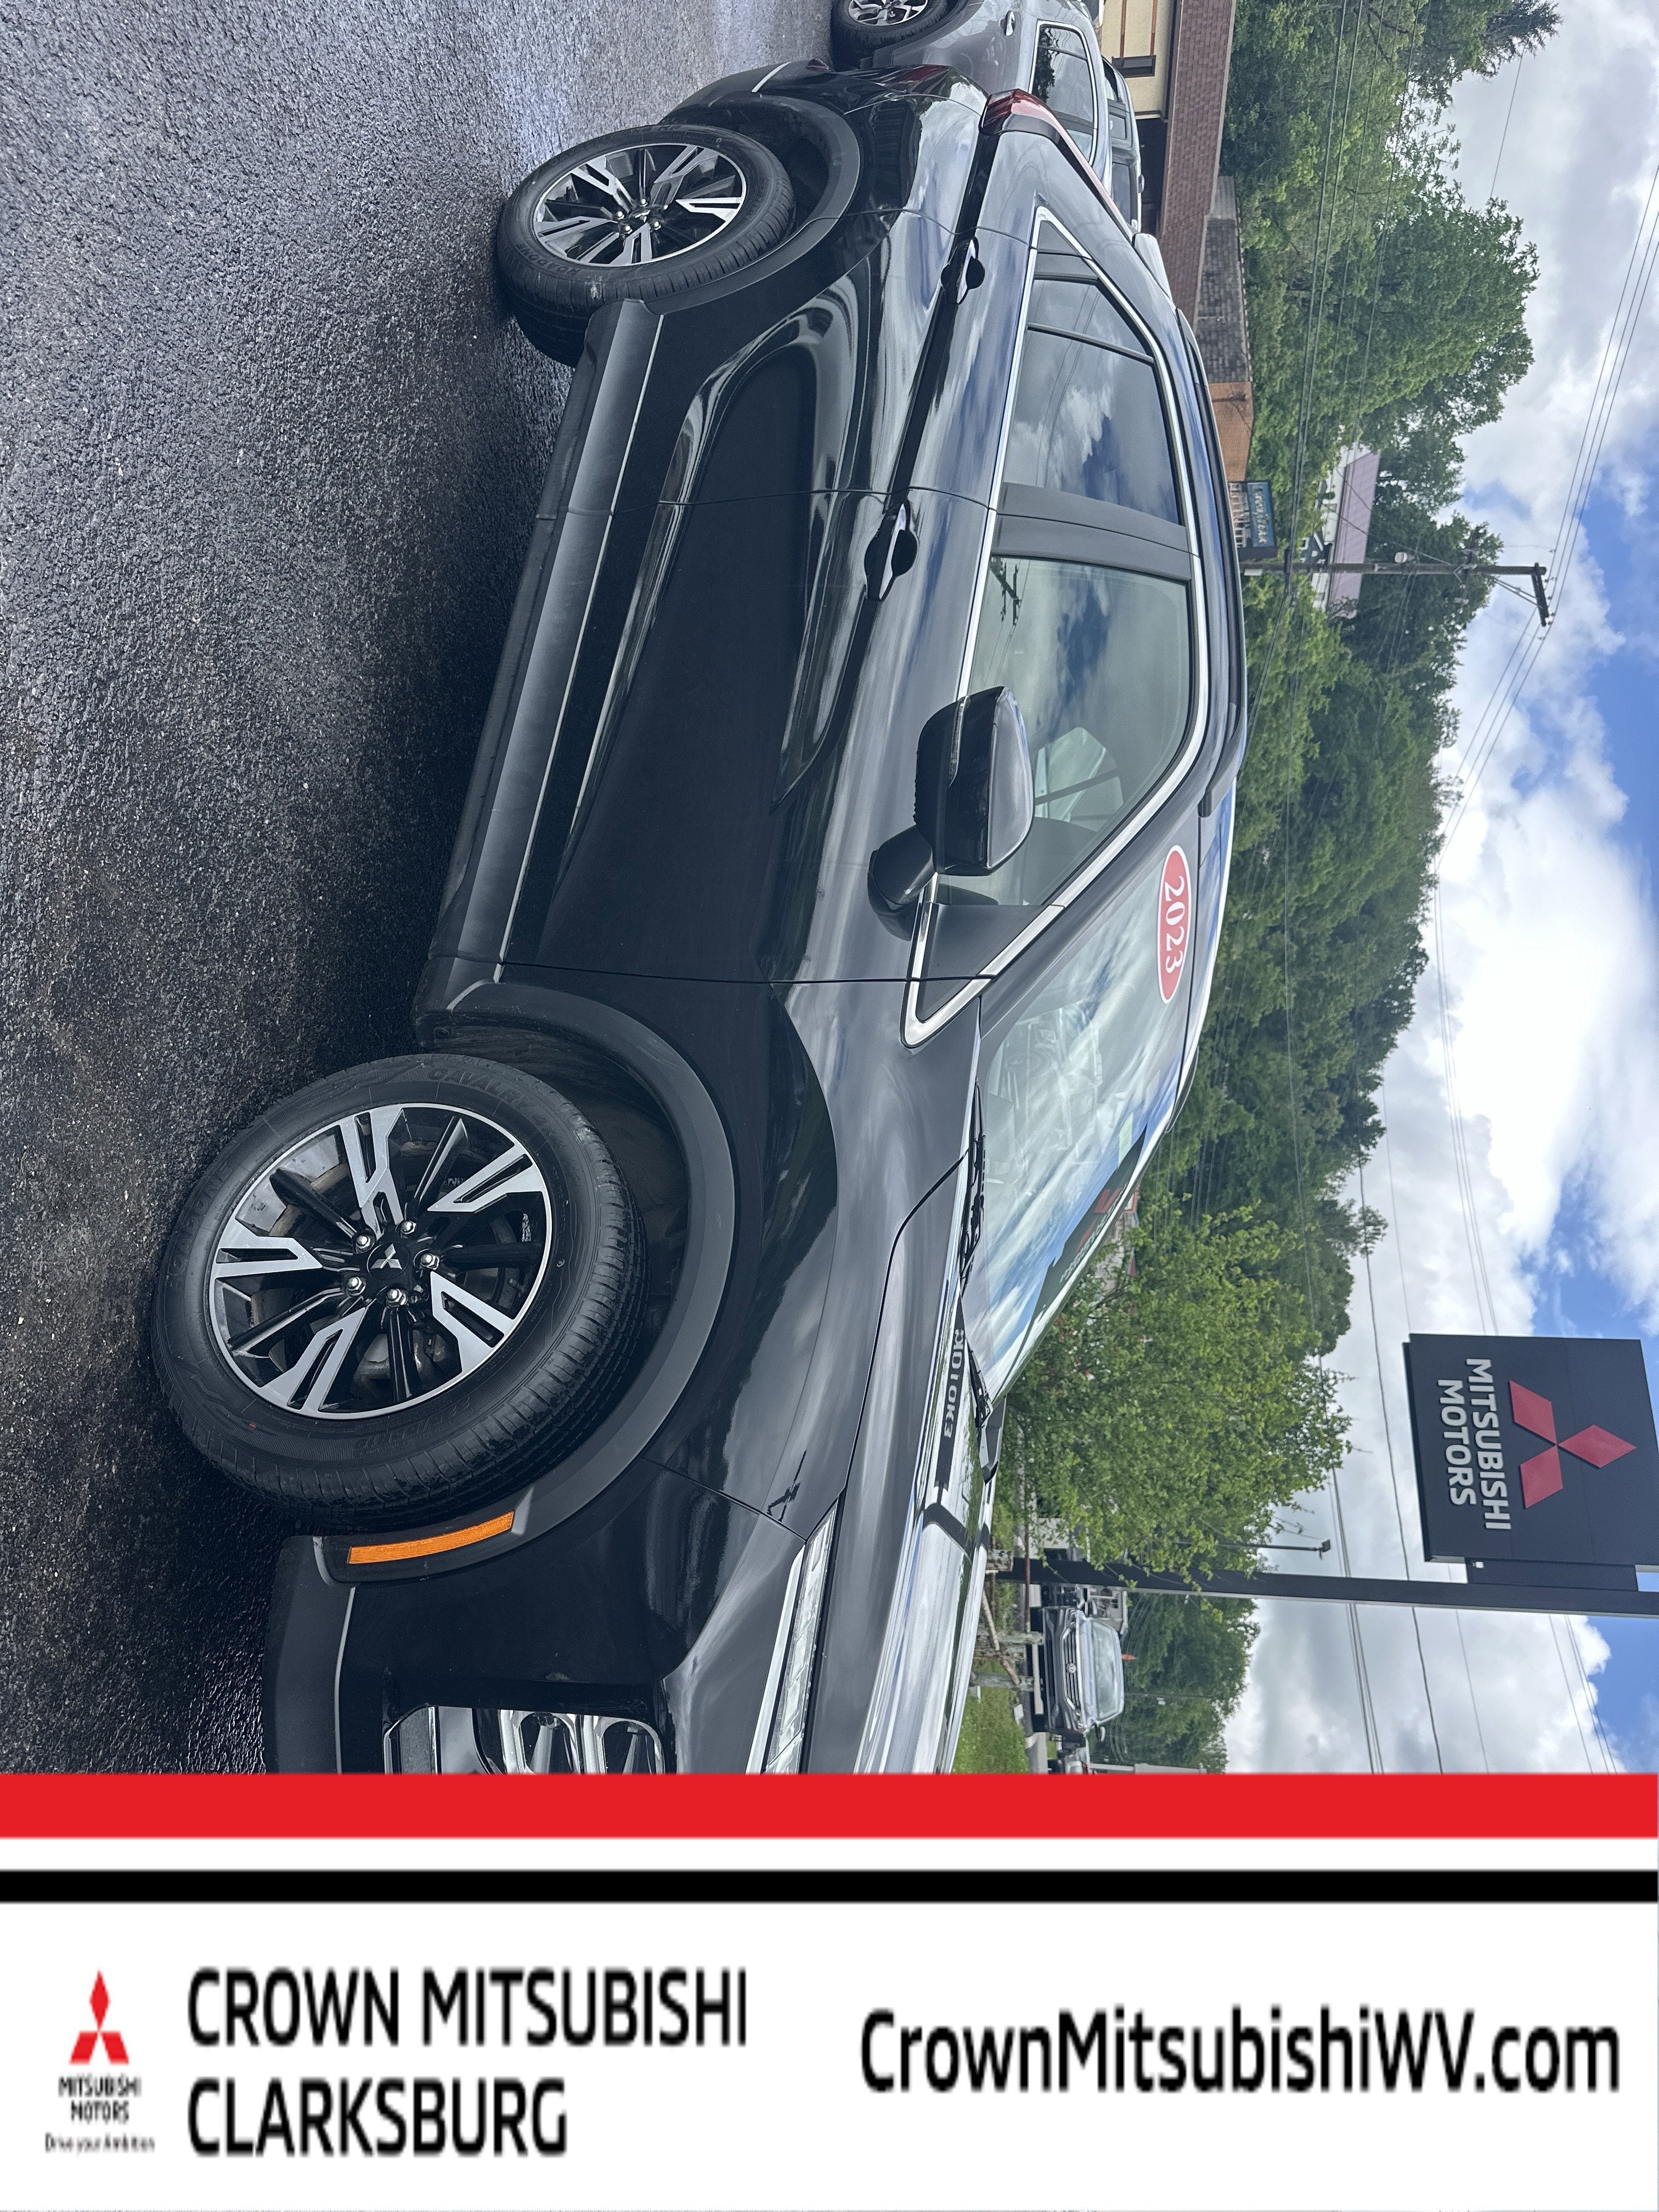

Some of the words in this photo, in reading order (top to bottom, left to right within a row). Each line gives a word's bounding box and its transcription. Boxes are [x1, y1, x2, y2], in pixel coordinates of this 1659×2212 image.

[1165, 876, 1186, 973] 2023
[167, 1163, 234, 1293] ROADONE
[1438, 1379, 1476, 1505] MOTORS
[1466, 1358, 1511, 1530] MITSUBISHI
